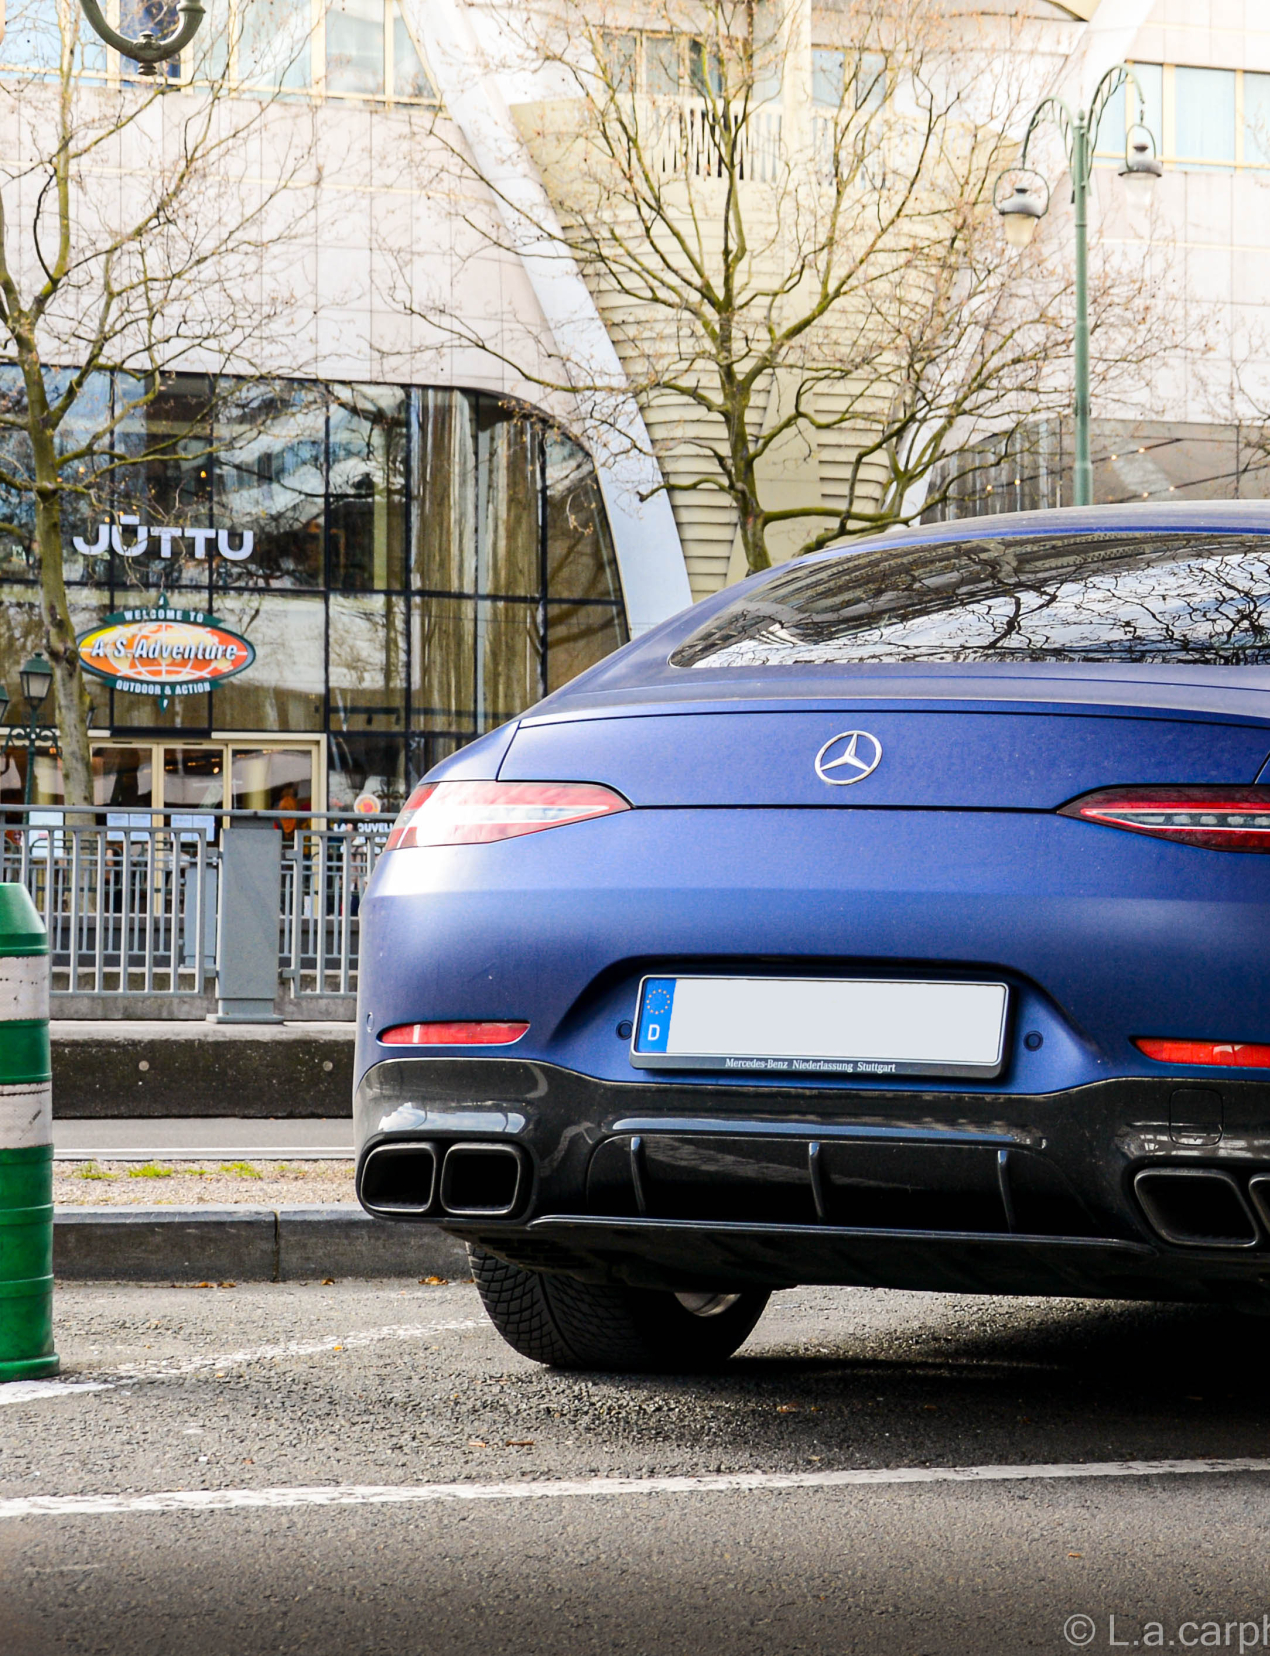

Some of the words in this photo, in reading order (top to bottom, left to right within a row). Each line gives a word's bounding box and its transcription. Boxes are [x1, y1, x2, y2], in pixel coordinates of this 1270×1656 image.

[124, 608, 183, 621] WELCOME
[189, 611, 204, 623] TO
[115, 679, 161, 695] OUTDOOR
[164, 685, 172, 695] &
[175, 681, 211, 695] ACTION
[647, 1024, 660, 1041] D
[725, 1057, 788, 1070] Mercedes-Benz
[792, 1060, 853, 1073] Niederlassung
[857, 1061, 896, 1074] Stuttgart
